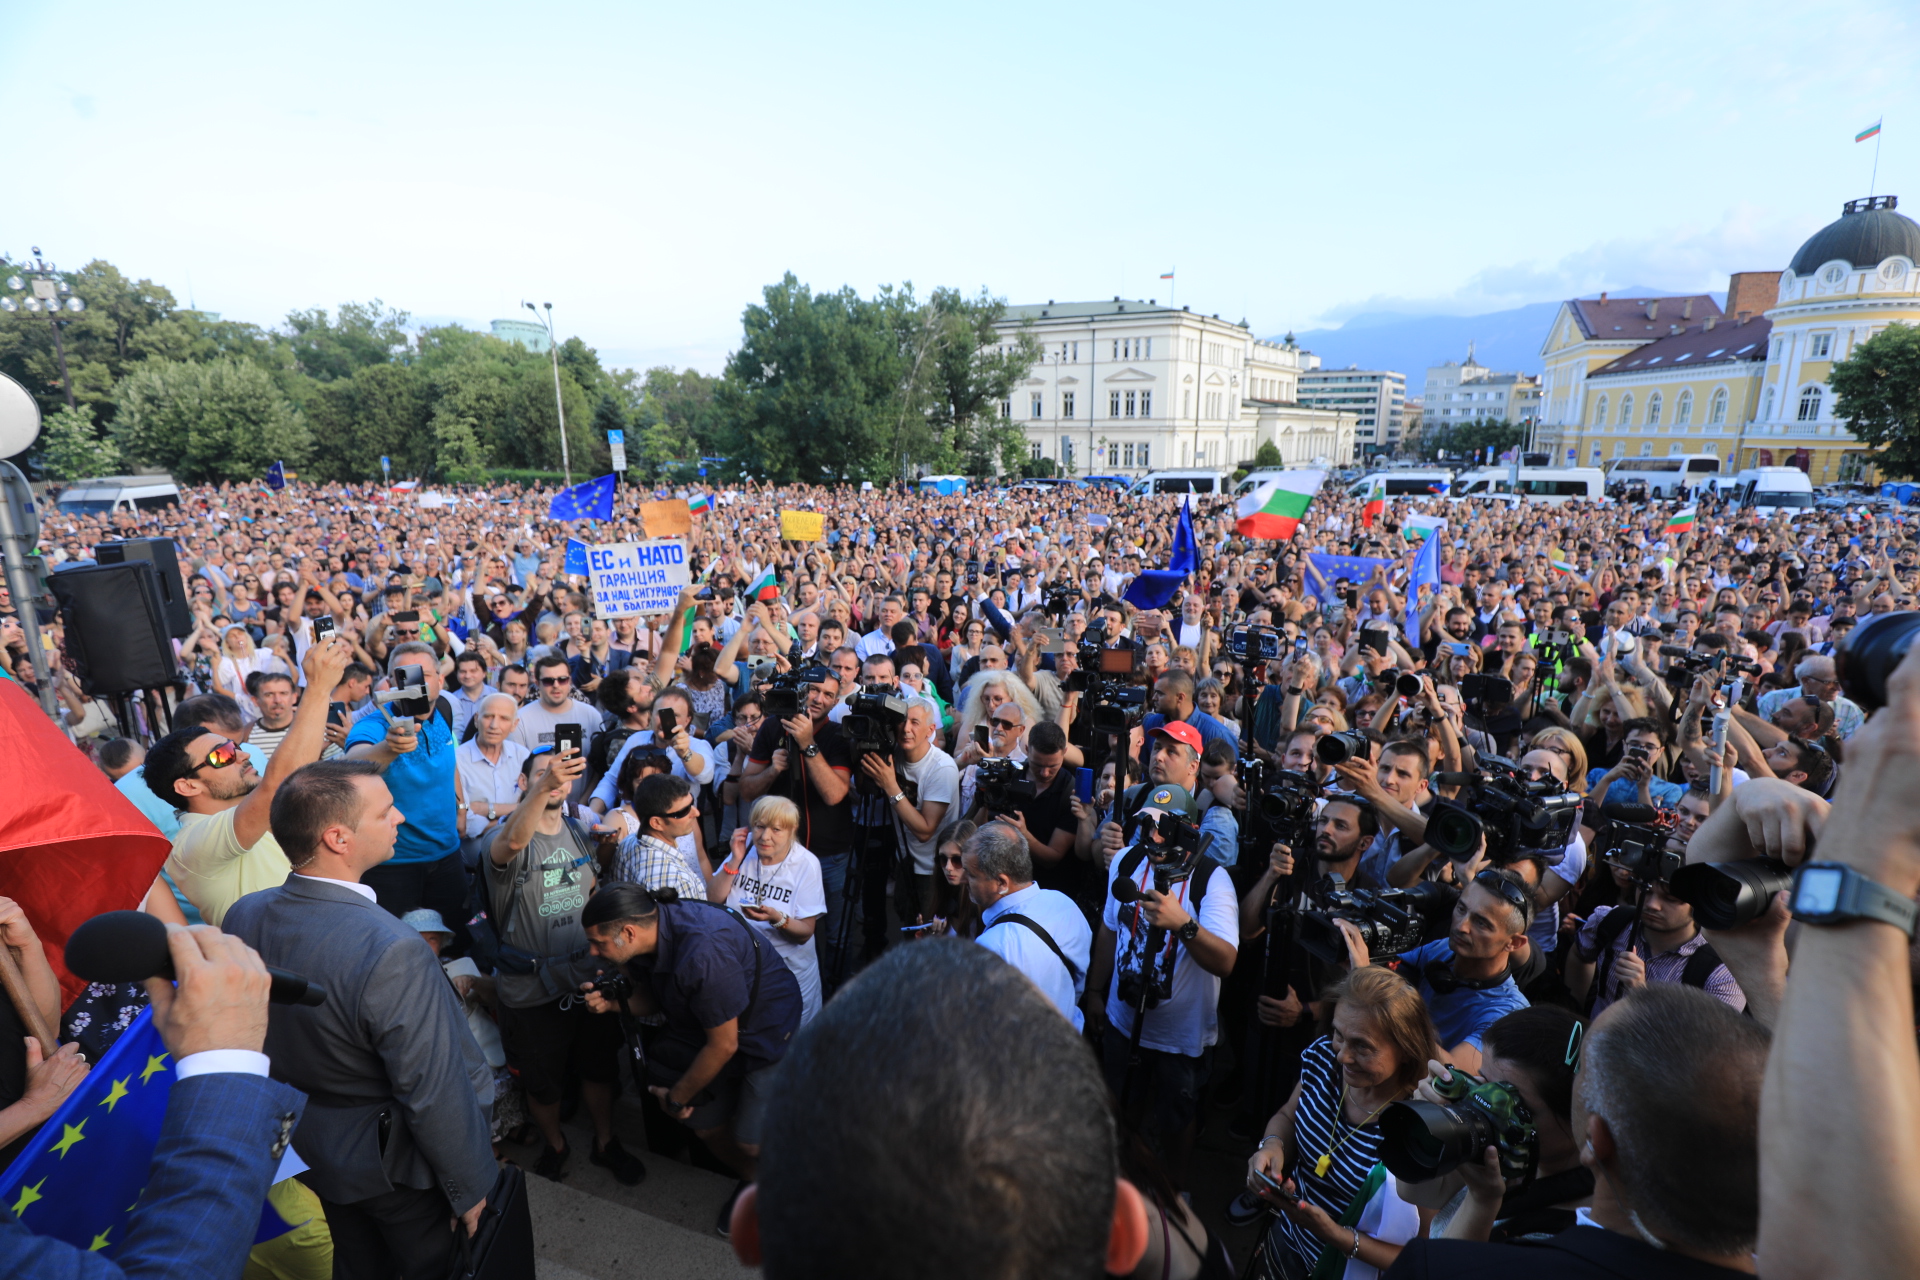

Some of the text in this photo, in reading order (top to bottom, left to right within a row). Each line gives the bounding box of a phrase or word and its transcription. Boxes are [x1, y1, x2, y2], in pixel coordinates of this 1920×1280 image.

[590, 544, 683, 571] ЕС и НАТО
[599, 569, 666, 588] ГАРАНЦИЯ
[597, 591, 609, 602] ЗА
[605, 603, 618, 613] НА
[624, 599, 669, 611] БЪЛГАРИЯ
[552, 916, 574, 929] ABB
[1473, 1093, 1492, 1109] Nikon
